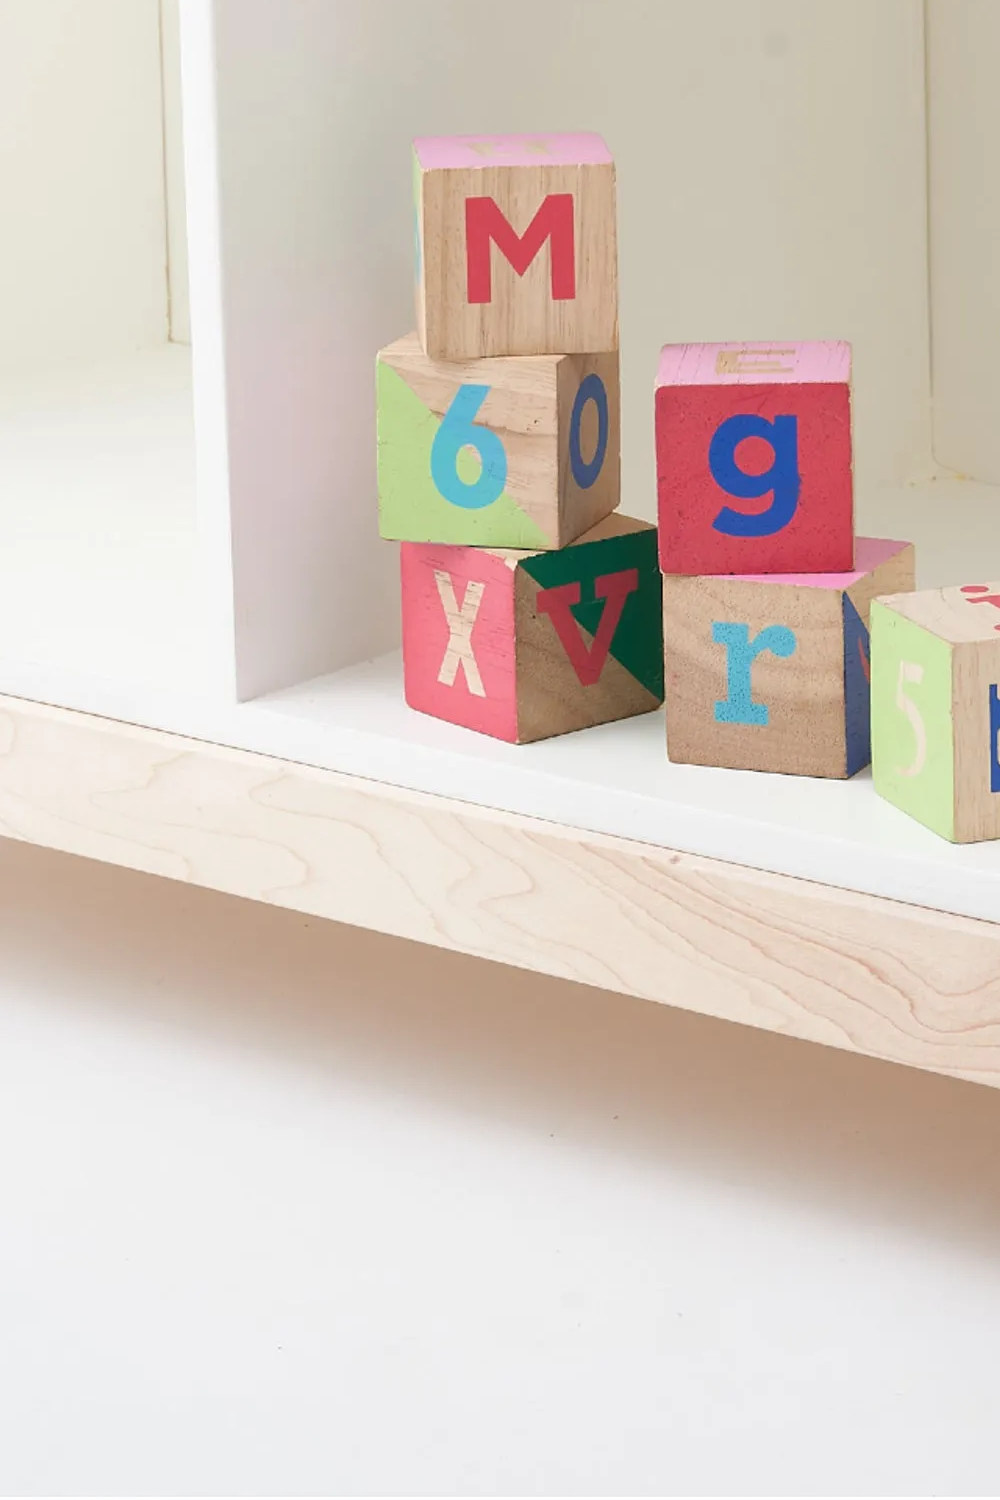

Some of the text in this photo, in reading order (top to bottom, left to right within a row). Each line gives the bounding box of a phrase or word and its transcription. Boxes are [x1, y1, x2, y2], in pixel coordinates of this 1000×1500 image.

[465, 193, 576, 304] M
[430, 383, 507, 510] 6
[708, 413, 802, 538] g
[433, 569, 487, 698] X
[536, 568, 638, 687] V
[711, 620, 797, 726] r
[896, 660, 928, 778] 5
